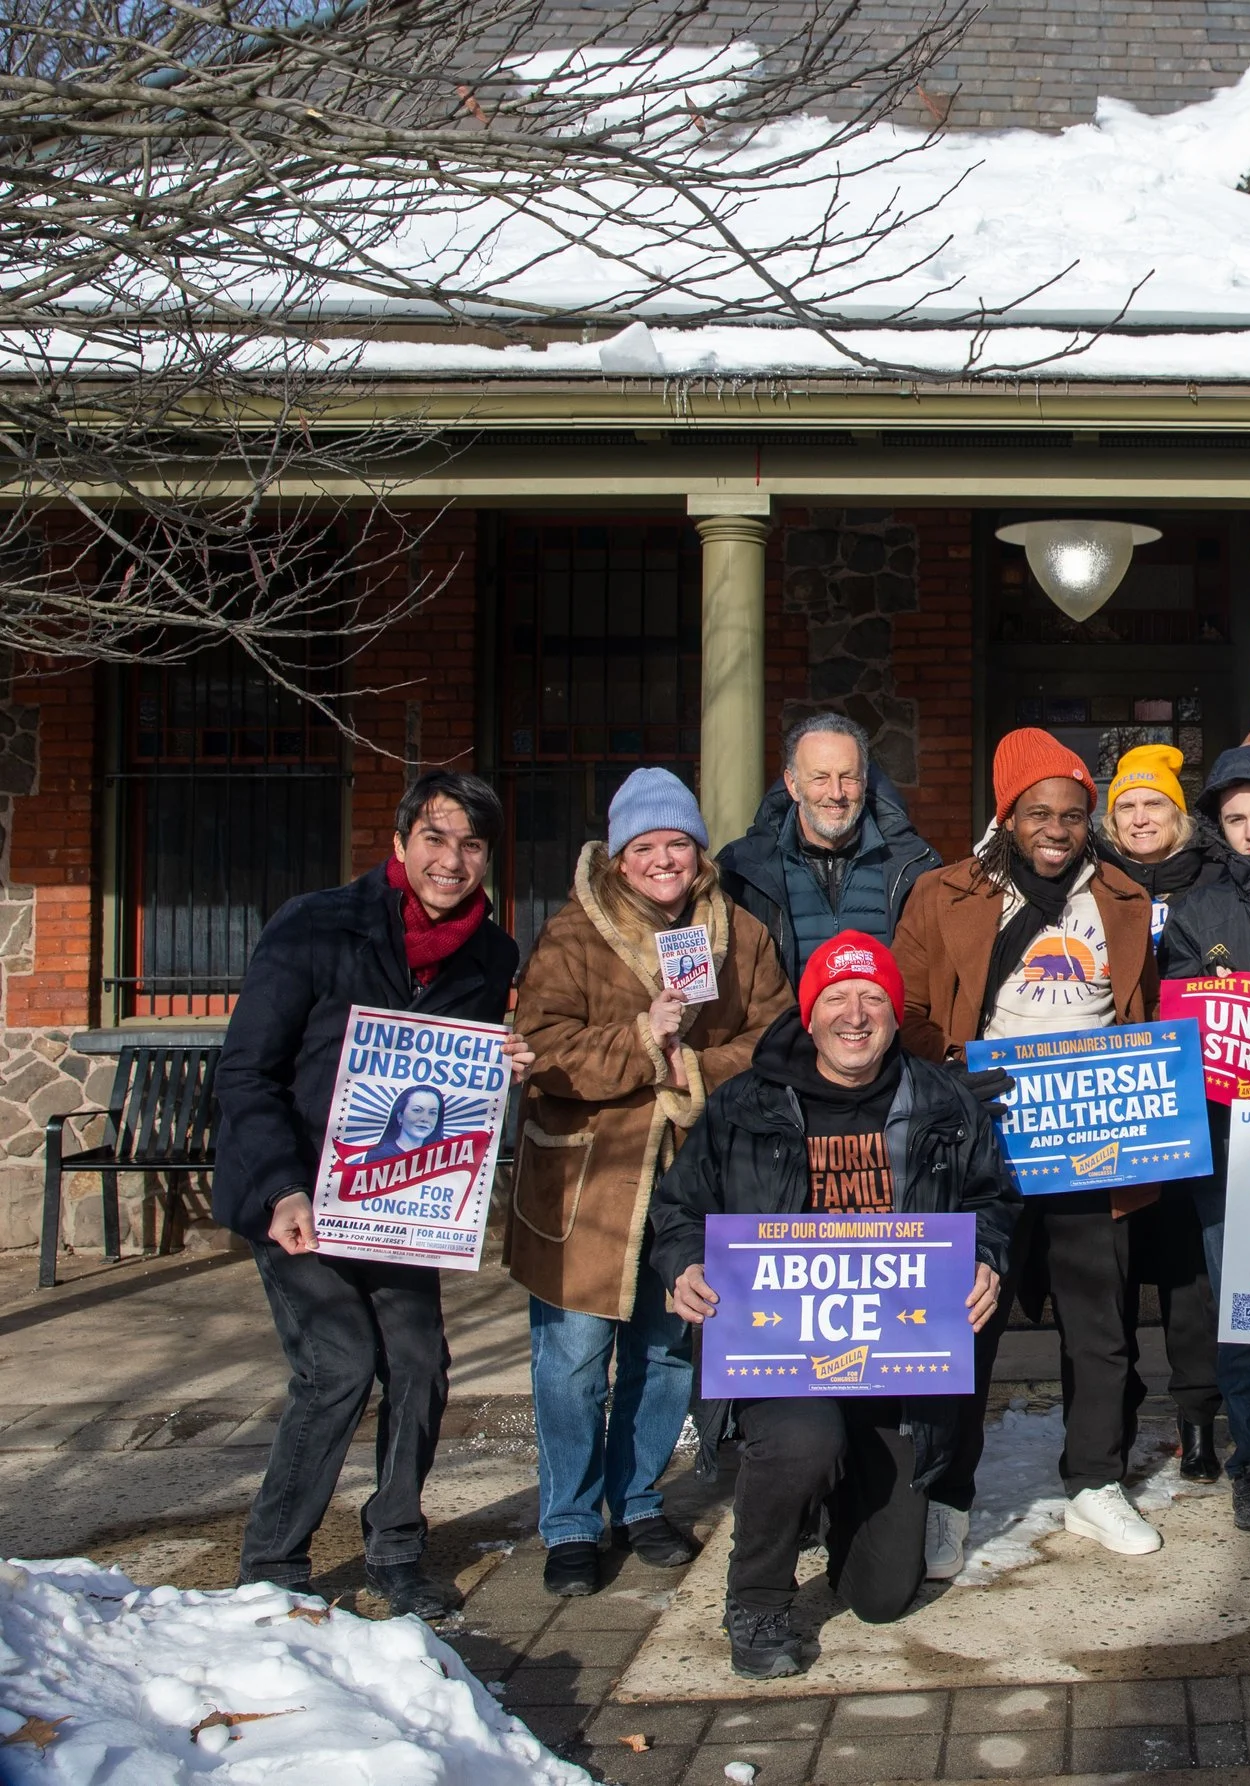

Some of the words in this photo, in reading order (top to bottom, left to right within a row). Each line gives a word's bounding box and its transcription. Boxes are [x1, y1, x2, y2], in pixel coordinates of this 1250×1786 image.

[659, 929, 705, 944] UNBOUGHT
[660, 937, 706, 952] UNBOSSED
[662, 951, 675, 959] FOR
[676, 964, 707, 990] ANALILIA
[1186, 978, 1236, 992] RIGHT
[354, 1021, 505, 1064] UNBOUGHT
[1015, 1044, 1035, 1060] TAX
[1037, 1036, 1106, 1057] BILLIONAIRES
[1109, 1035, 1123, 1049] TO
[1124, 1031, 1152, 1047] FUND
[349, 1048, 505, 1092] UNBOSSED
[1002, 1091, 1179, 1134] HEALTHCARE
[1030, 1133, 1063, 1149] AND
[1067, 1124, 1147, 1144] CHILDCARE
[348, 1139, 474, 1196] ANALILIA
[1079, 1146, 1115, 1172] ANALILIA
[420, 1185, 454, 1203] FOR
[361, 1197, 451, 1220] CONGRESS
[317, 1218, 370, 1231] ANALILIA
[373, 1223, 407, 1235] MEJIA
[417, 1228, 433, 1238] FOR
[436, 1230, 453, 1240] ALL
[454, 1232, 465, 1241] OF
[466, 1234, 477, 1243] US
[382, 1237, 406, 1245] JERSEY
[758, 1222, 788, 1239] KEEP
[791, 1222, 816, 1239] OUR
[818, 1221, 893, 1238] COMMUNITY
[895, 1221, 924, 1238] SAFE
[752, 1254, 926, 1290] ABOLISH
[799, 1293, 882, 1341] ICE
[821, 1350, 863, 1376] ANALILIA
